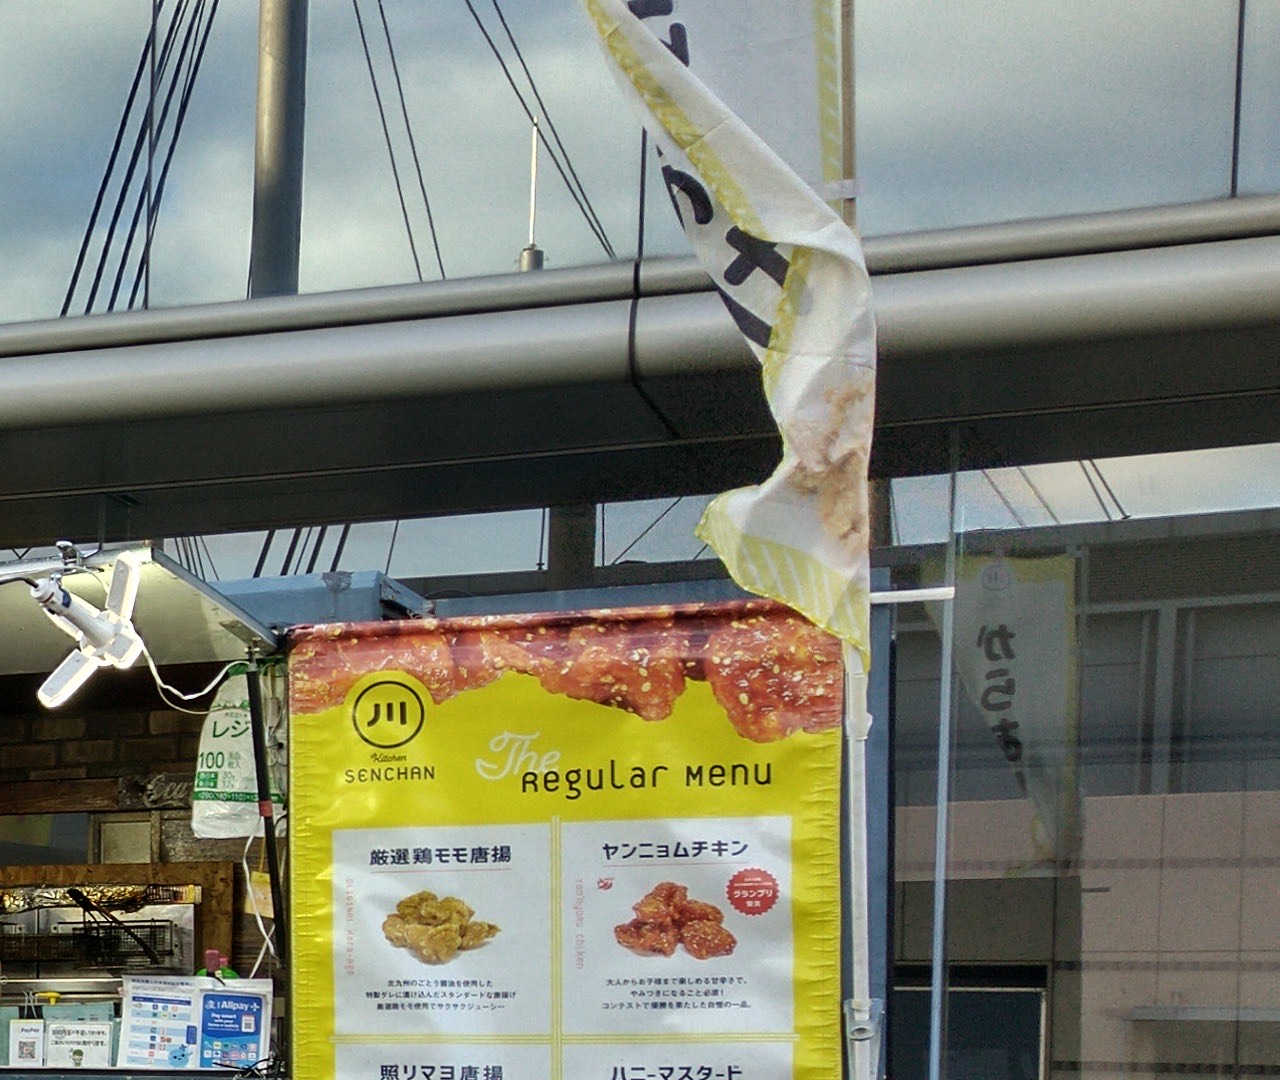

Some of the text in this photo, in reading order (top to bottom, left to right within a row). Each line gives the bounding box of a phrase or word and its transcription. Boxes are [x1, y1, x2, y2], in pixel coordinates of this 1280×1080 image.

[199, 751, 225, 769] 100
[475, 732, 562, 781] The
[345, 766, 435, 783] SENCHAN
[521, 763, 773, 799] Regular Menu
[369, 846, 512, 867] 厳選鶏モモ唐揚
[602, 839, 749, 861] ヤンニョムチキン
[733, 889, 773, 898] グランプリ
